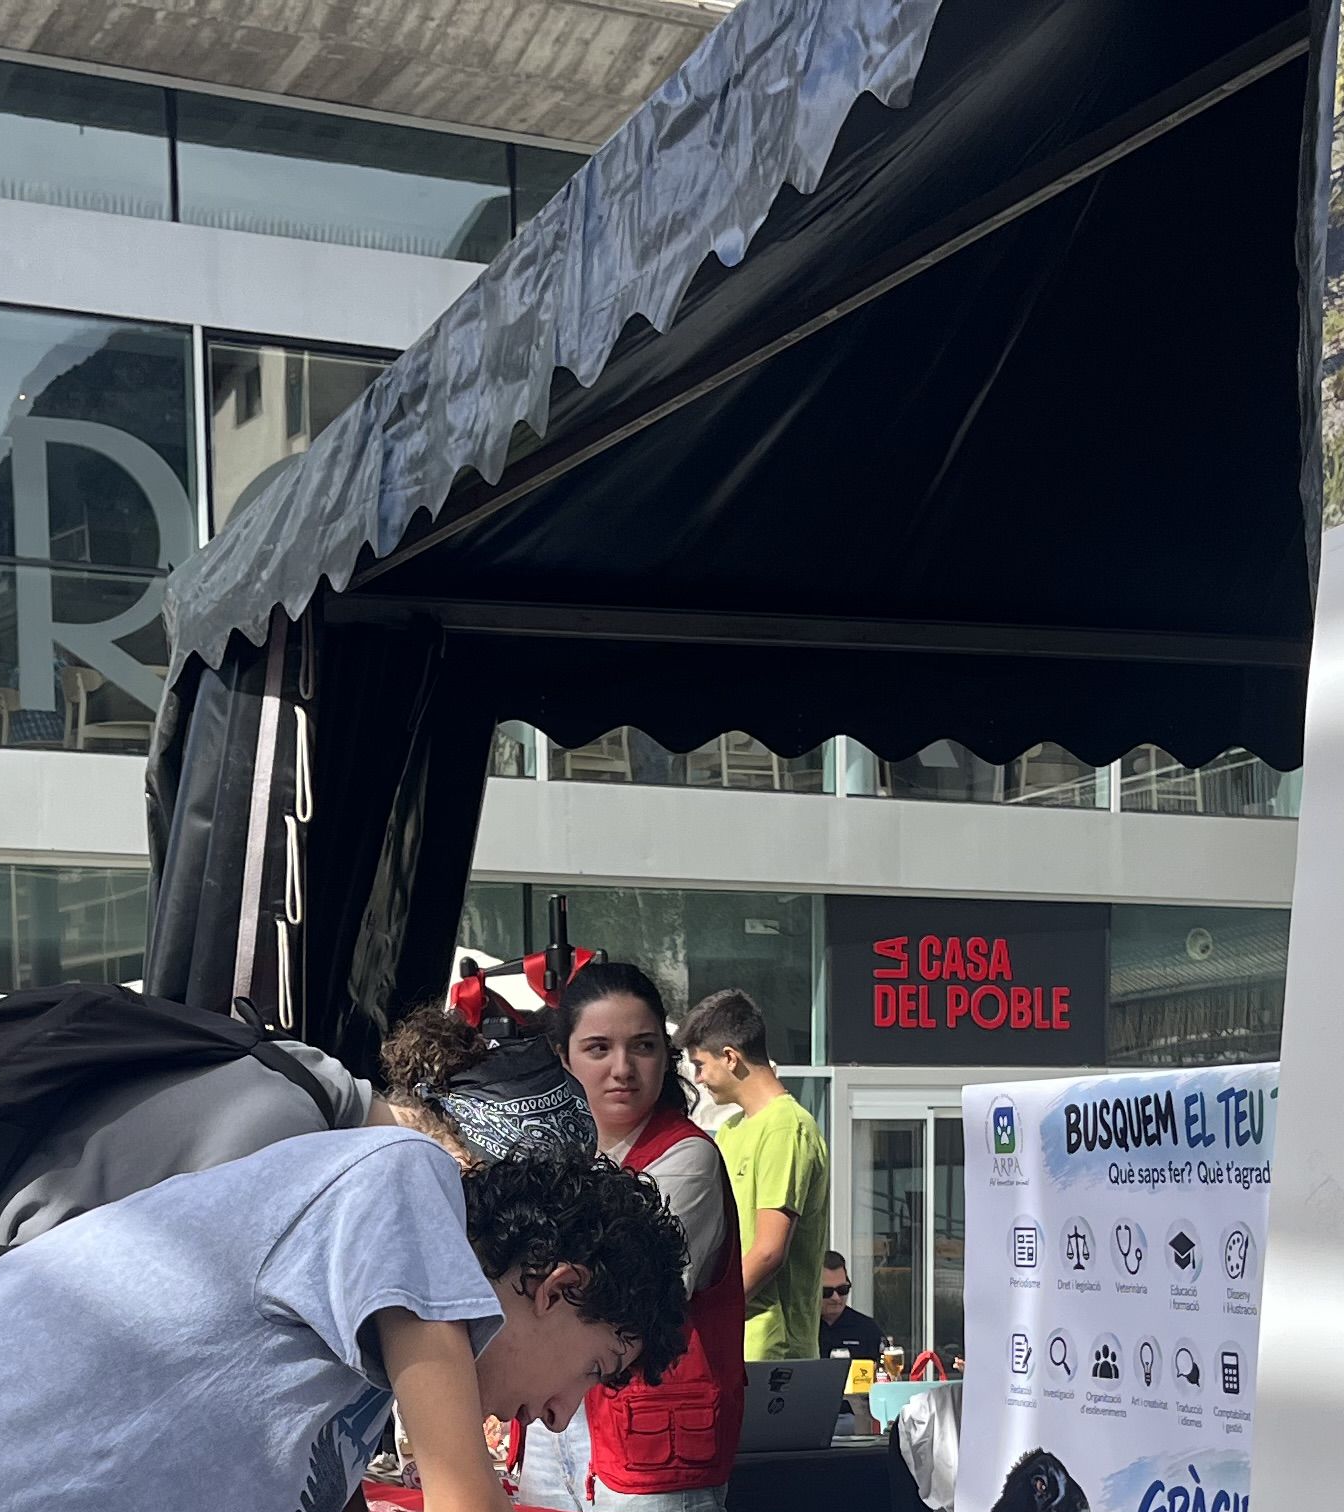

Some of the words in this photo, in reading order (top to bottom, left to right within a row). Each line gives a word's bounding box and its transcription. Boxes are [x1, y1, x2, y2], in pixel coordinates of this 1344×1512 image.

[873, 936, 909, 979] LA
[918, 935, 1013, 981] CASA
[874, 984, 936, 1029] DEL
[947, 984, 1071, 1030] POBLE
[1064, 1089, 1179, 1154] BUSQUEM
[1184, 1091, 1216, 1149] EL
[1216, 1086, 1264, 1149] TEU
[993, 1157, 1023, 1177] ARPA
[1108, 1162, 1135, 1187] Què
[1138, 1166, 1166, 1190] saps
[1168, 1160, 1192, 1184] fer?
[1197, 1160, 1224, 1185] Què
